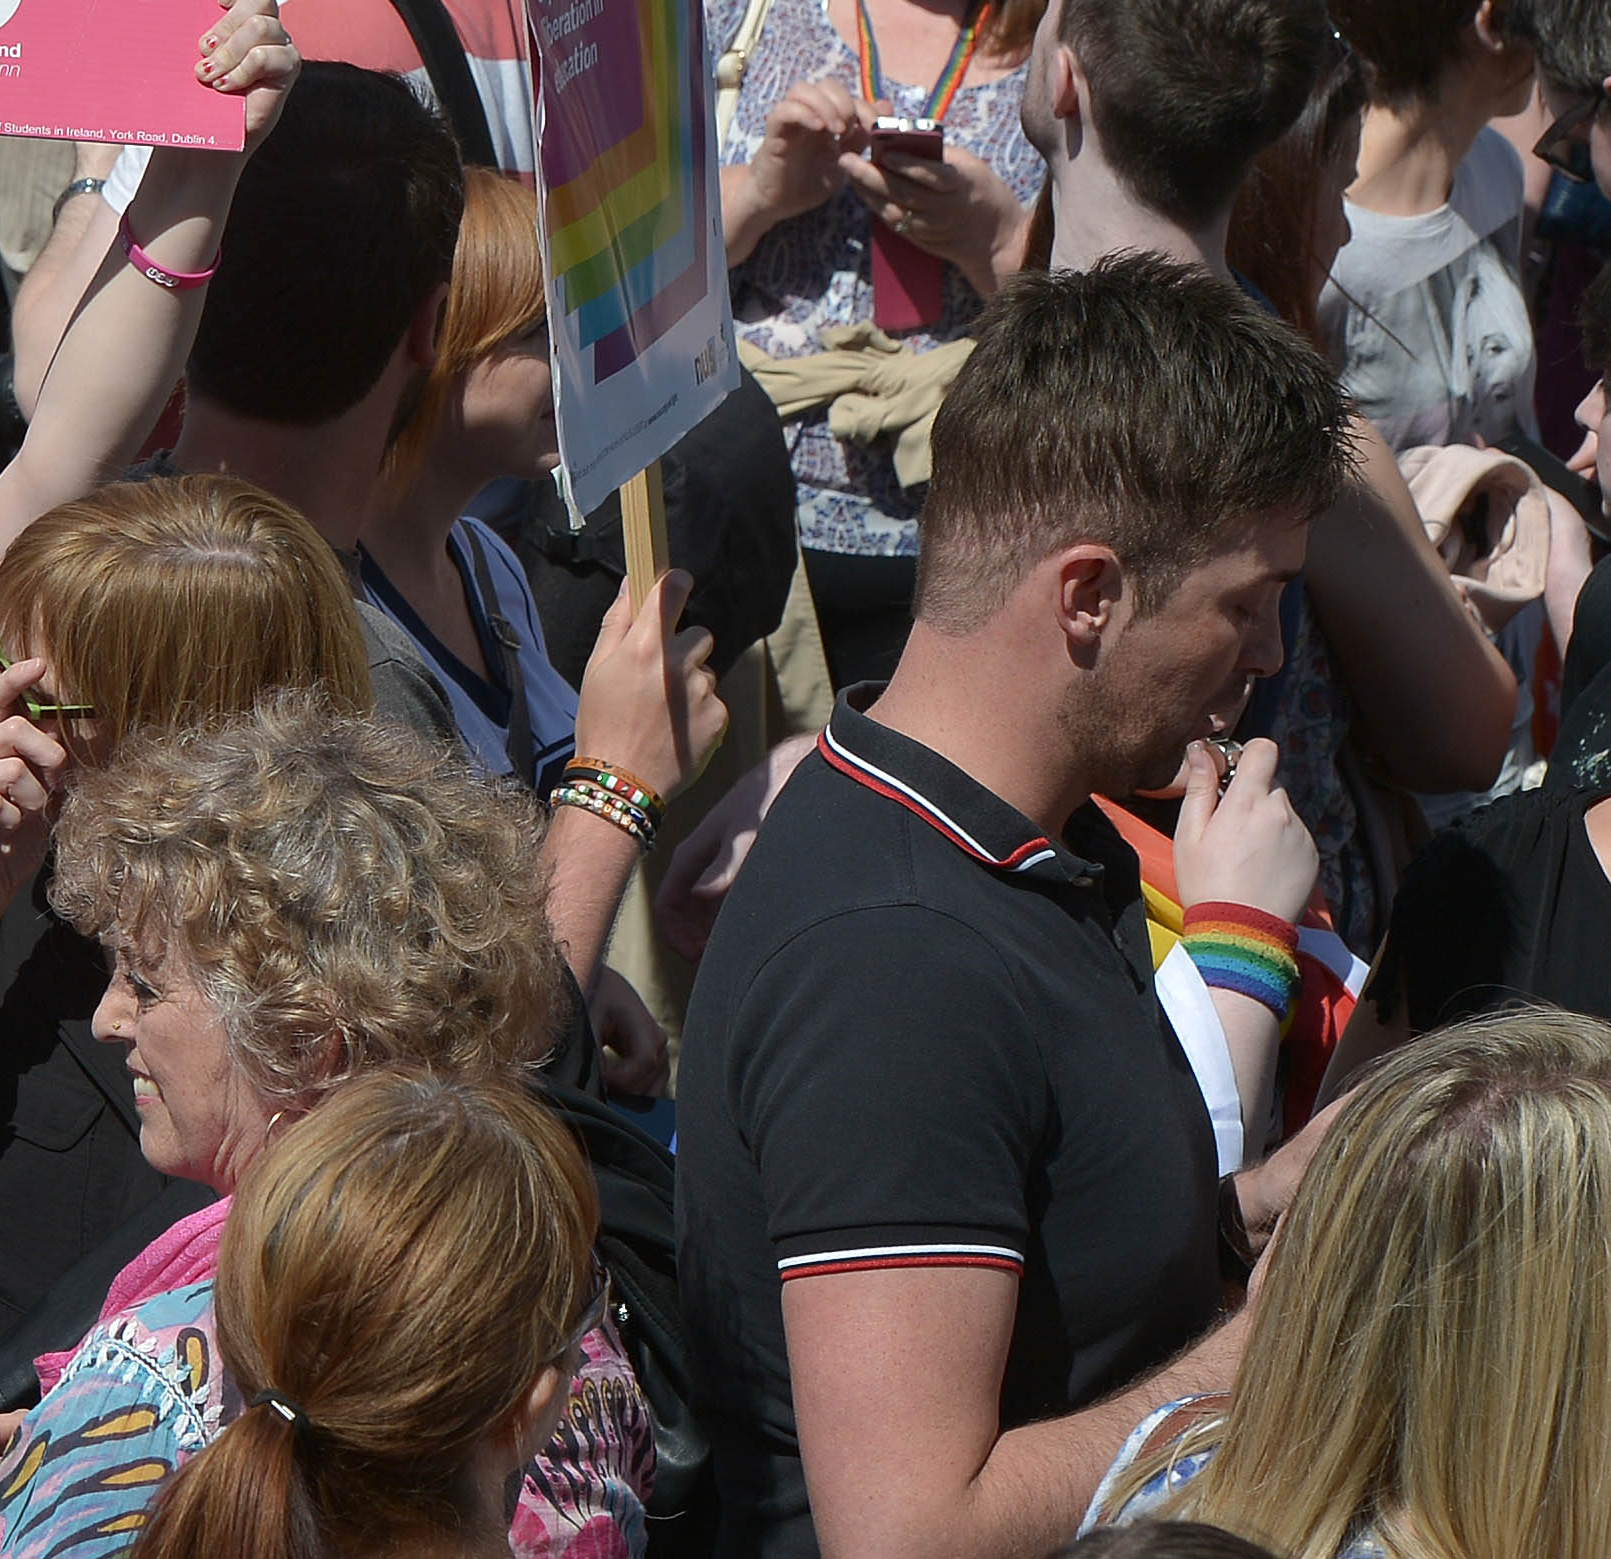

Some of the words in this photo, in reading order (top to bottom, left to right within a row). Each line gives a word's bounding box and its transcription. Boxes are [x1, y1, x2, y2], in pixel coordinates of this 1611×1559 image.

[4, 122, 51, 136] Students
[110, 129, 134, 141] York
[172, 132, 206, 146] Dublin
